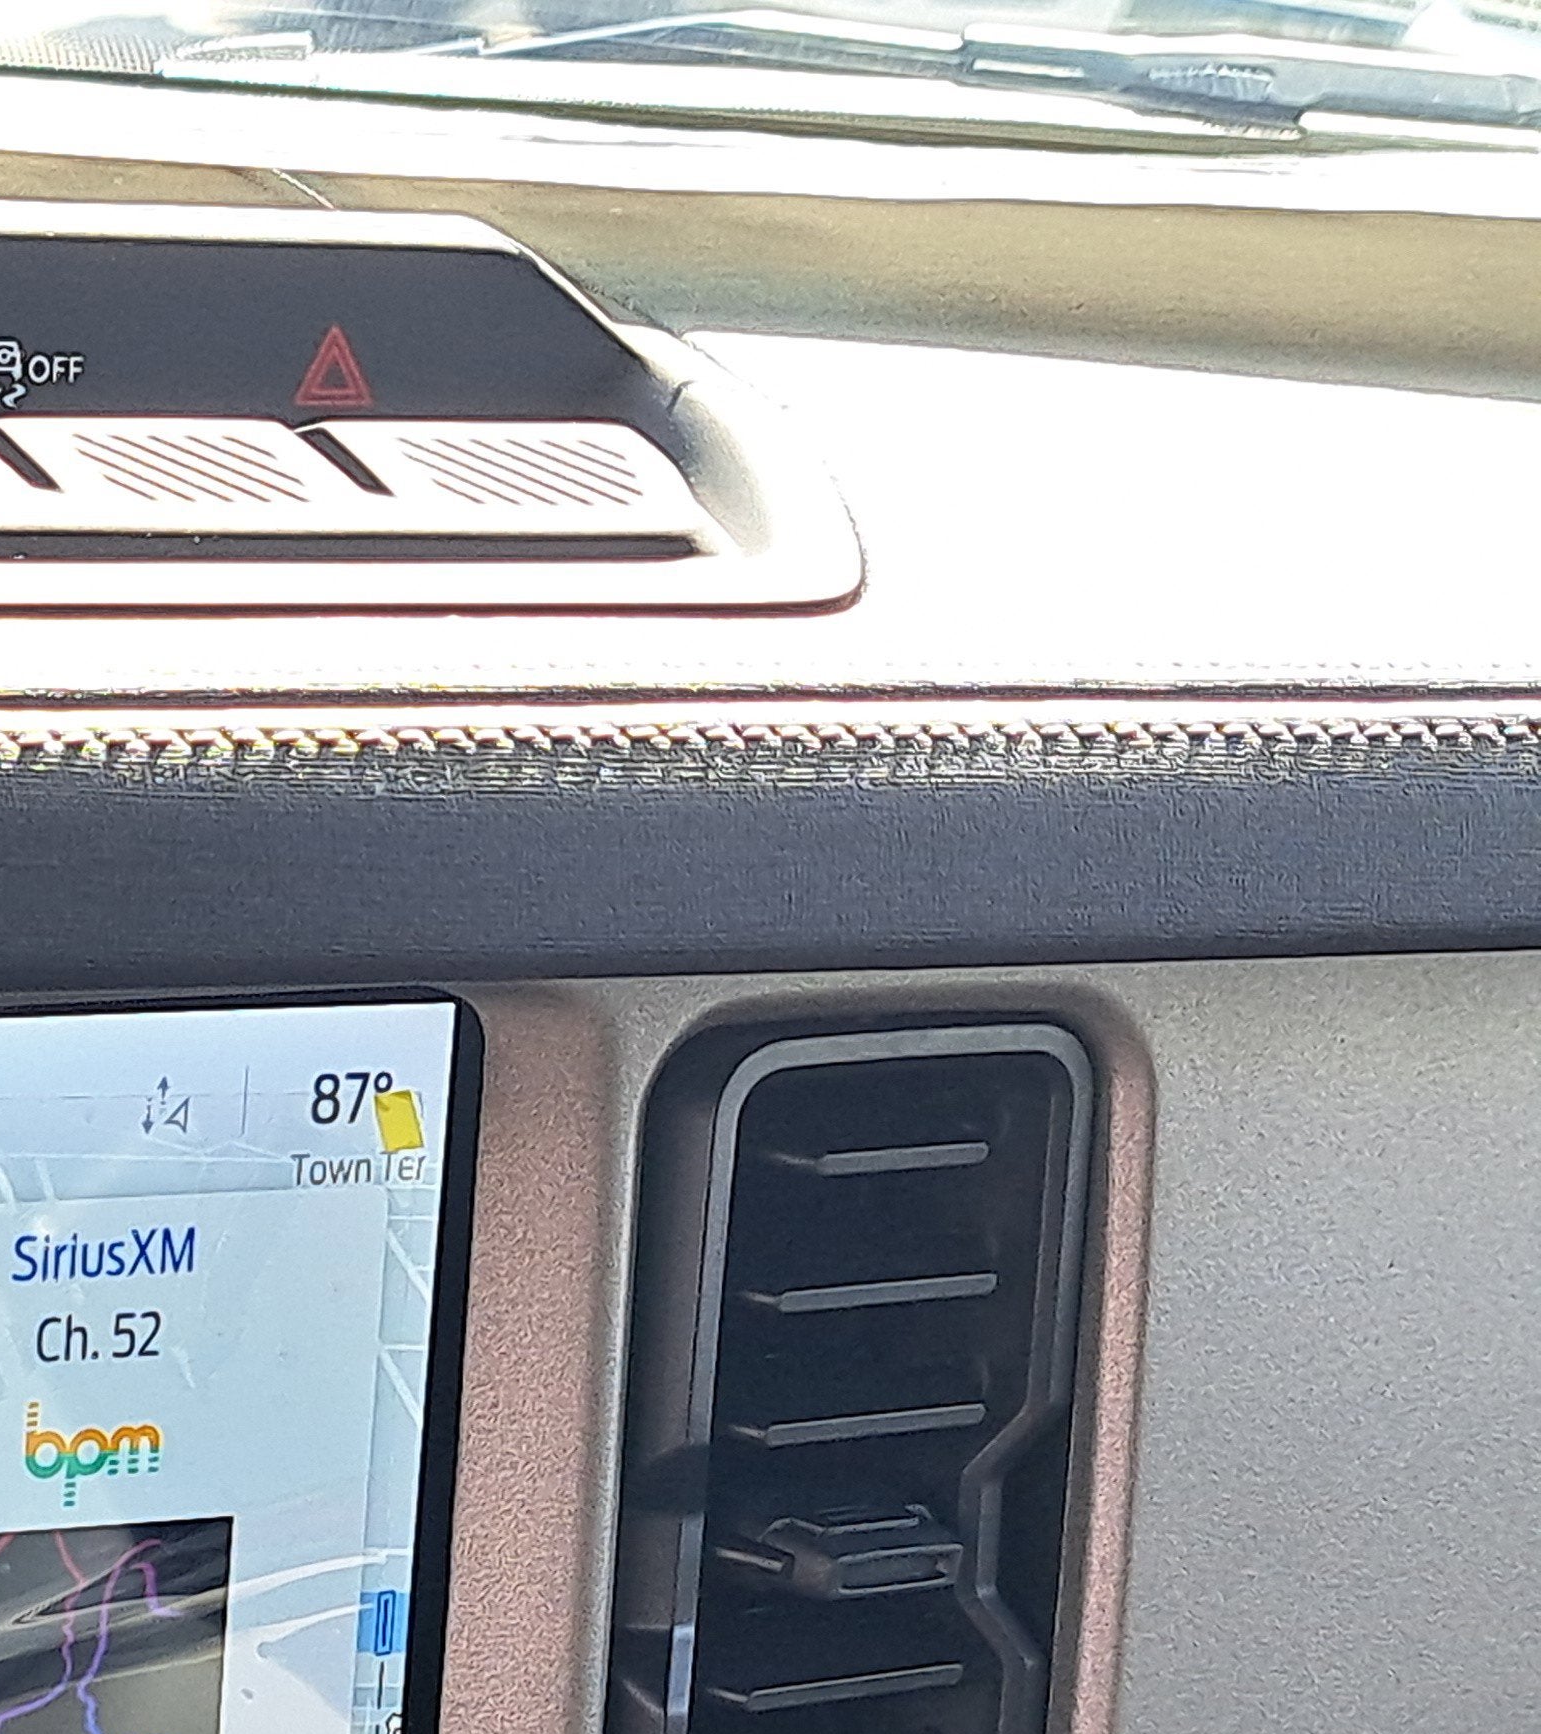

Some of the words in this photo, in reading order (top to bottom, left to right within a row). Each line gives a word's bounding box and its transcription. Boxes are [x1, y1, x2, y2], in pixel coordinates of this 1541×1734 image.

[27, 354, 85, 384] OFF
[311, 1071, 393, 1125] 87°
[290, 1152, 372, 1186] Town
[380, 1151, 427, 1181] Ter
[12, 1226, 196, 1282] SiriusXM
[36, 1315, 102, 1363] Ch.
[112, 1311, 163, 1359] 52
